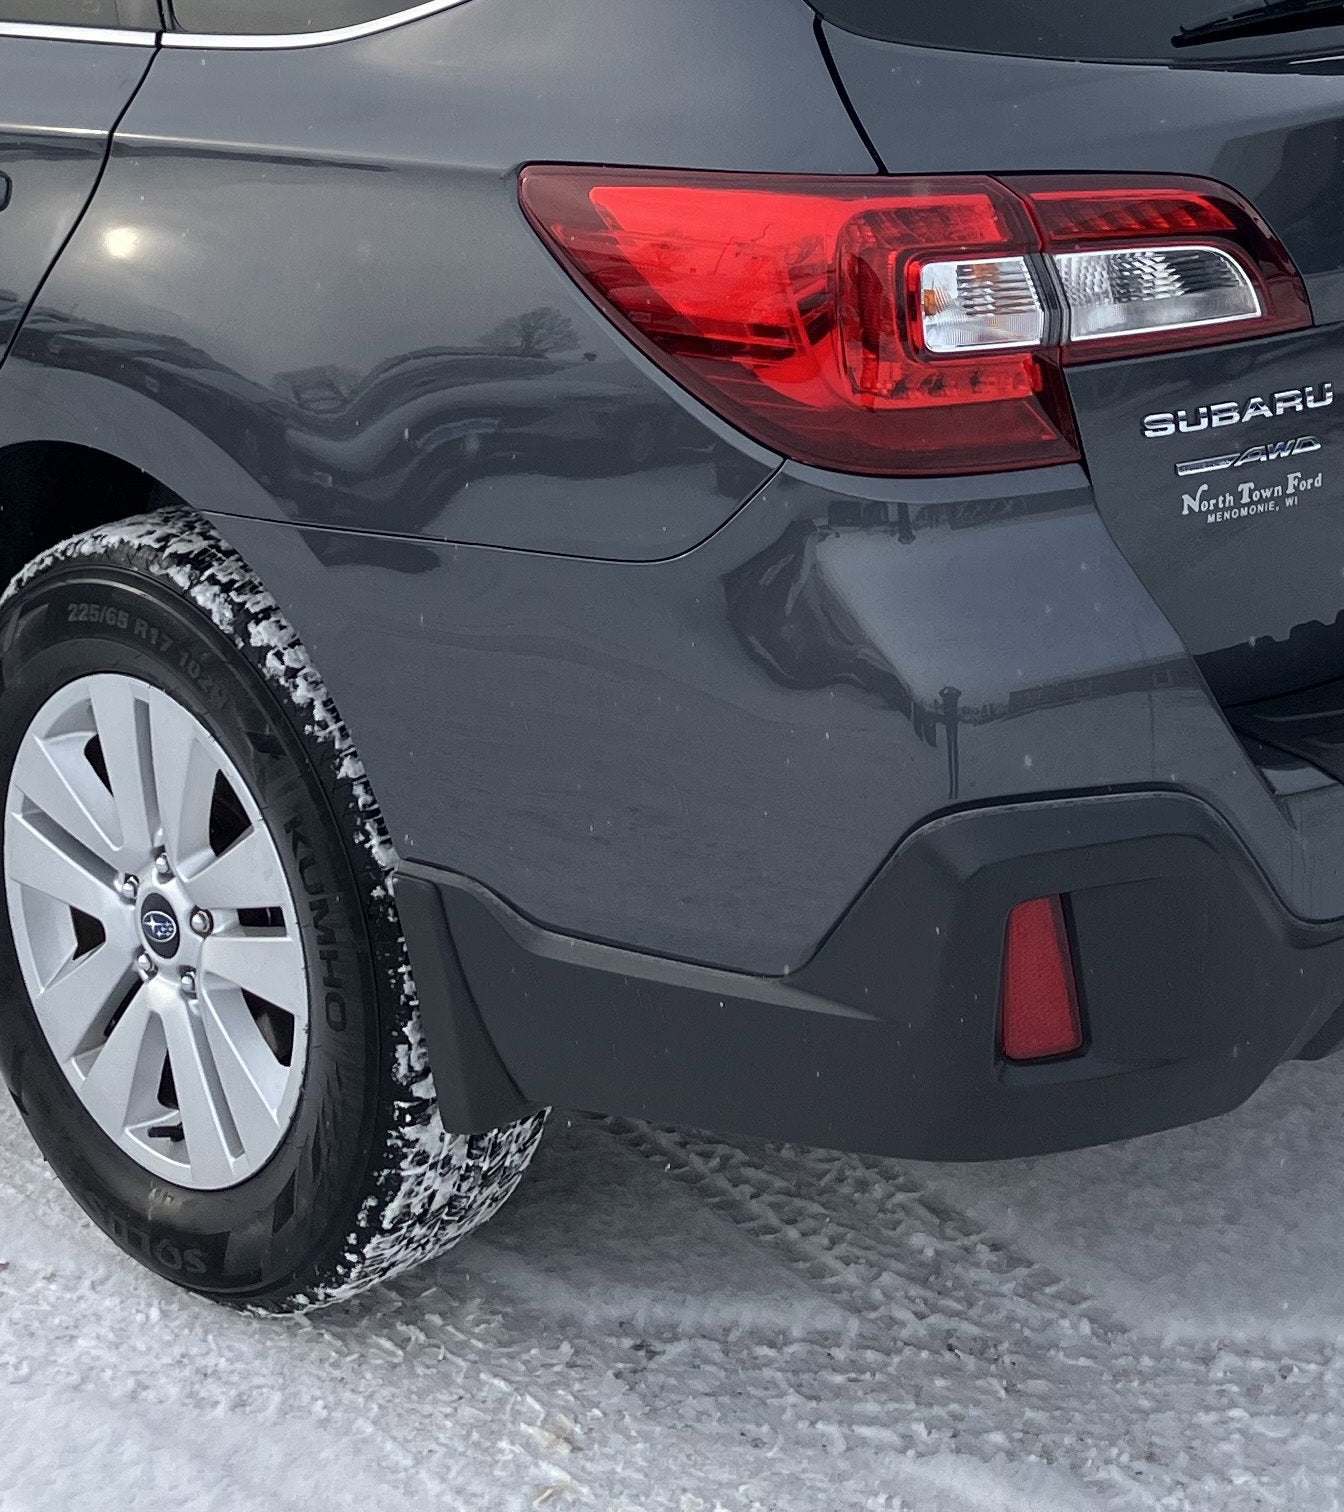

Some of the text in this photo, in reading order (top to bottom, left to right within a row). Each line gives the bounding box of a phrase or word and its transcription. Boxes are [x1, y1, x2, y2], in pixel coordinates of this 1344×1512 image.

[1143, 382, 1334, 438] SUBARU
[1234, 435, 1322, 467] AWD
[1181, 472, 1323, 515] North Town Ford
[1207, 495, 1298, 524] MENOMONIE, WI
[67, 603, 129, 630] 225/65
[133, 617, 174, 652] R17
[283, 814, 347, 1033] KUMHO
